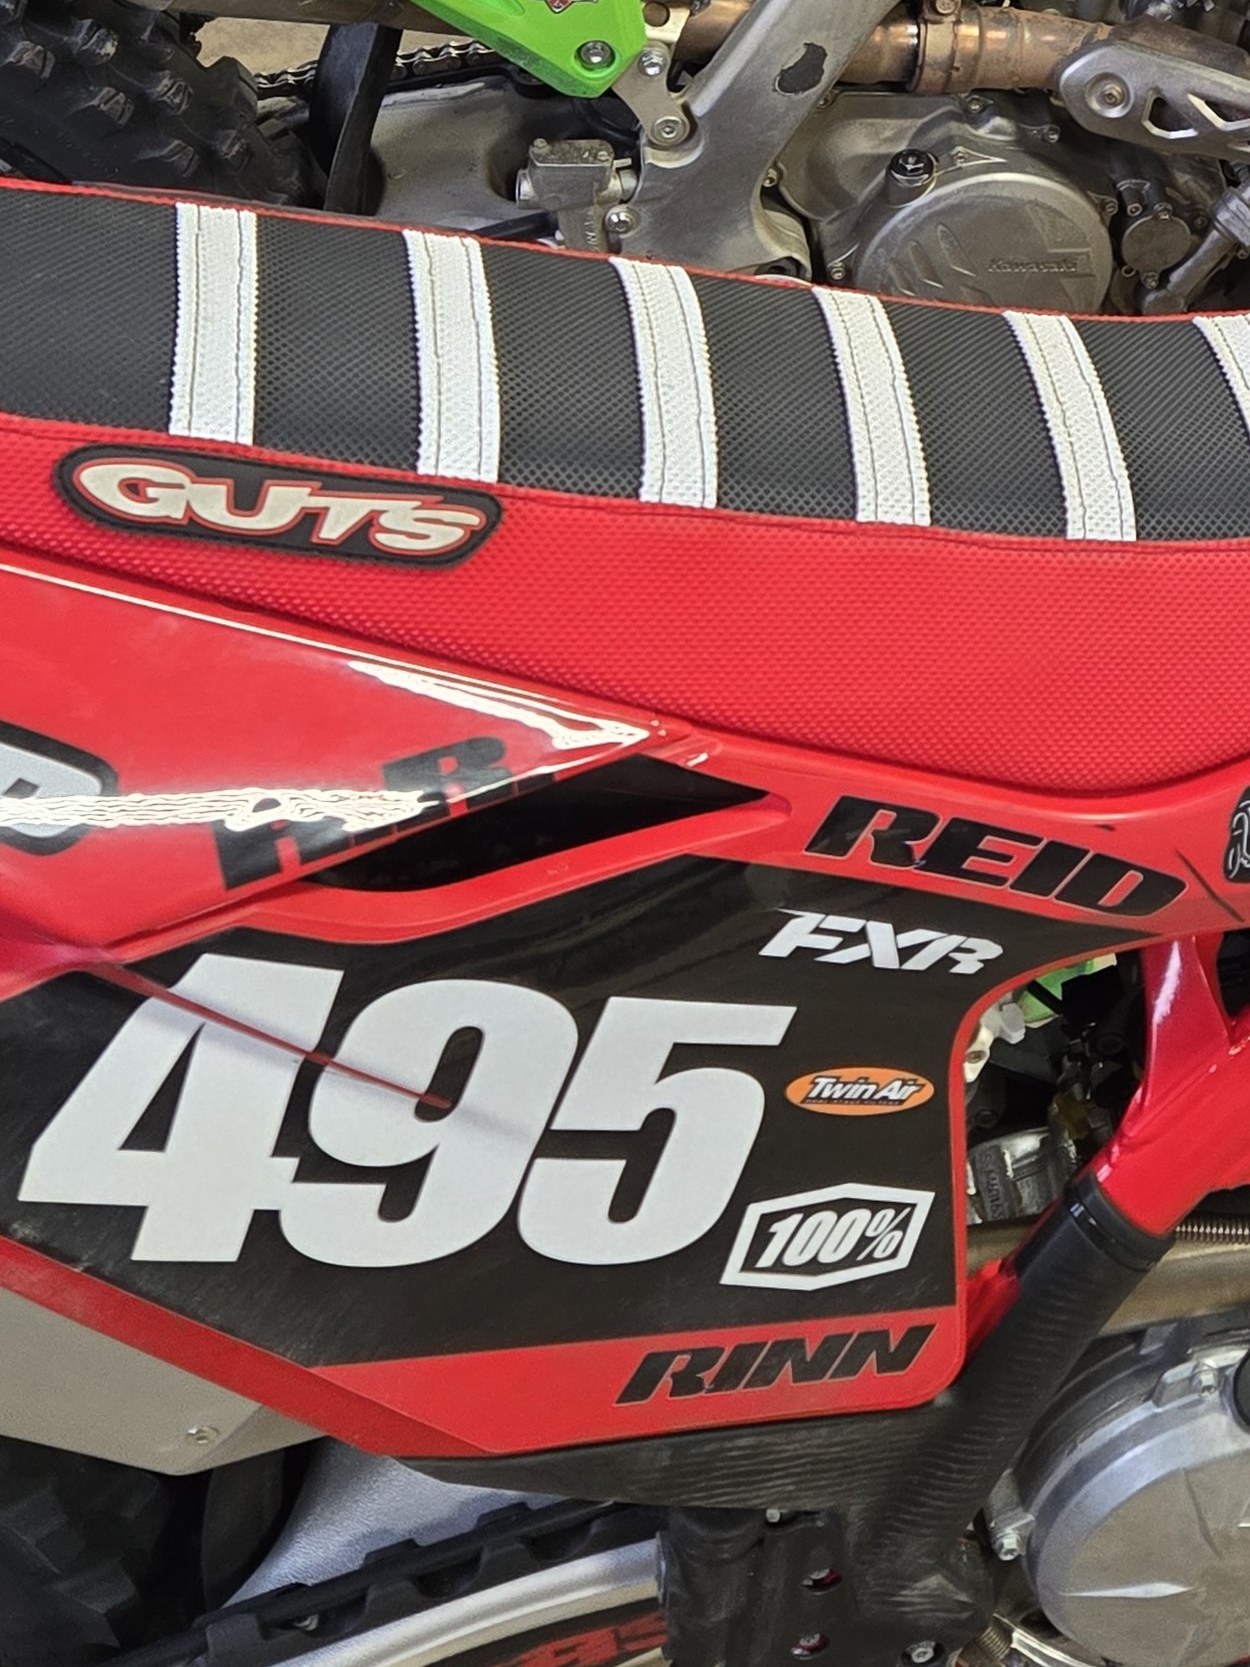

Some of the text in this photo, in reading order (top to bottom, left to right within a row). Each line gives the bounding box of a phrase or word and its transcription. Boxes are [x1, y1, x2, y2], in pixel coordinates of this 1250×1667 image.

[74, 458, 487, 555] GUTS
[804, 795, 1190, 918] REID
[759, 907, 1004, 976] FXR
[17, 953, 798, 1268] 495
[808, 1076, 923, 1101] Twin Air
[752, 1205, 912, 1269] 100%
[614, 1323, 939, 1406] RINN
